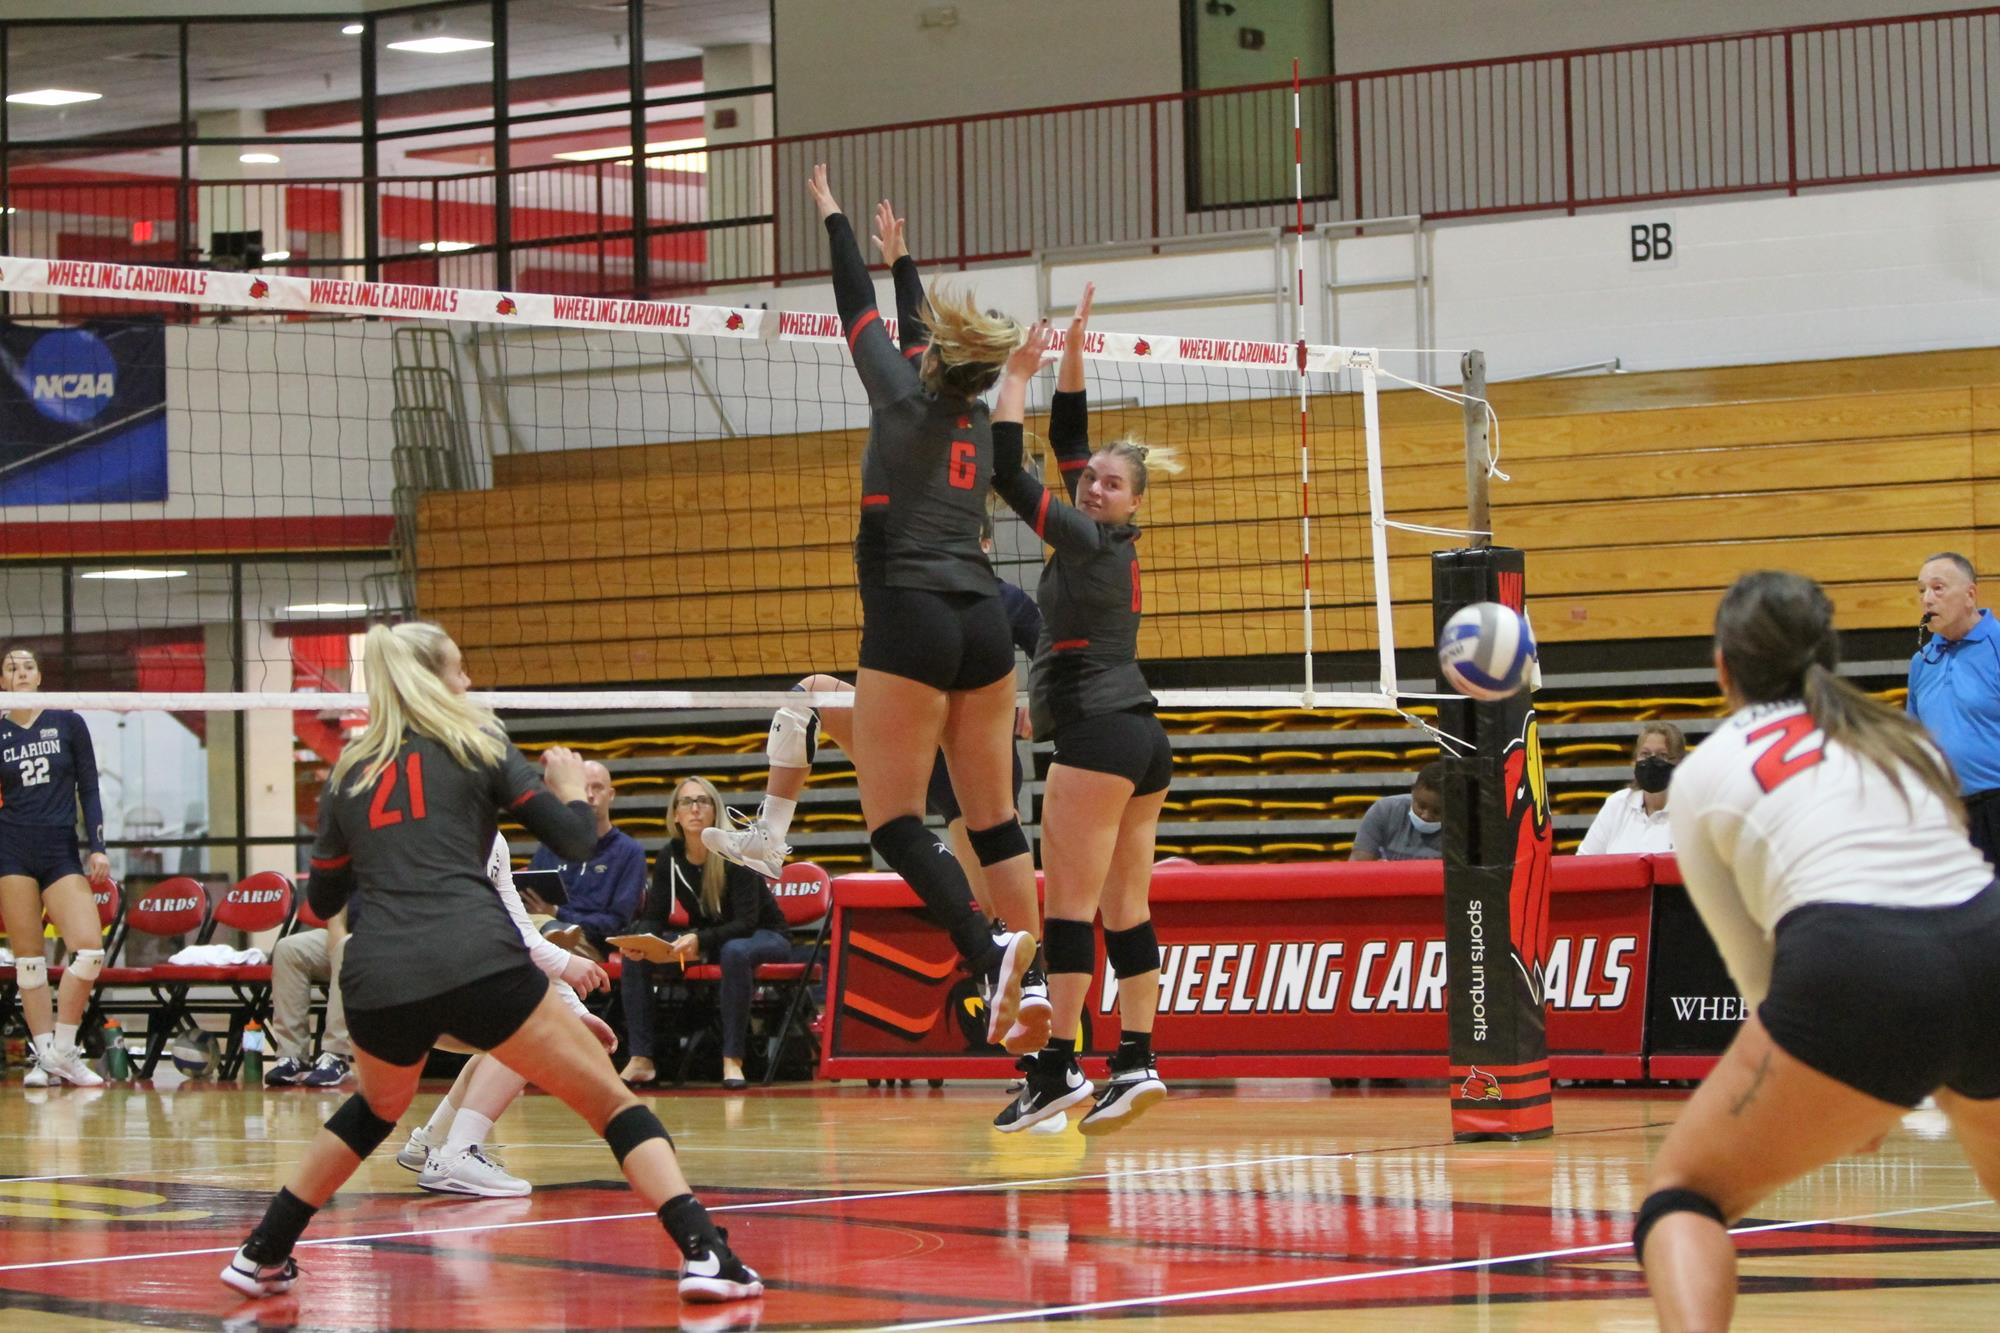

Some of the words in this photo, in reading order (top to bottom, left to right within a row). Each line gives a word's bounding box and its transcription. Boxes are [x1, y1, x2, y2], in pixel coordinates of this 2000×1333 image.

[1631, 222, 1673, 262] BB
[47, 261, 122, 290] WHEELING
[124, 266, 208, 296] CARDINALS
[309, 279, 380, 307] WHEELING
[381, 284, 459, 313] CARDINALS
[553, 296, 619, 323] WHEELING
[619, 301, 691, 328] CARDINALS
[779, 311, 838, 338] WHEELING
[1179, 338, 1231, 362] WHEELING
[1231, 341, 1289, 365] CARDINALS
[33, 373, 115, 400] NCAA
[948, 439, 976, 491] 6
[3, 739, 60, 763] CLARION
[1745, 712, 1827, 795] 2
[19, 756, 50, 787] 22
[365, 751, 427, 830] 21
[138, 896, 198, 912] CARDS
[226, 888, 284, 904] CARDS
[766, 880, 821, 897] ARDS
[1467, 900, 1486, 962] sports
[1350, 936, 1637, 1011] CARALS
